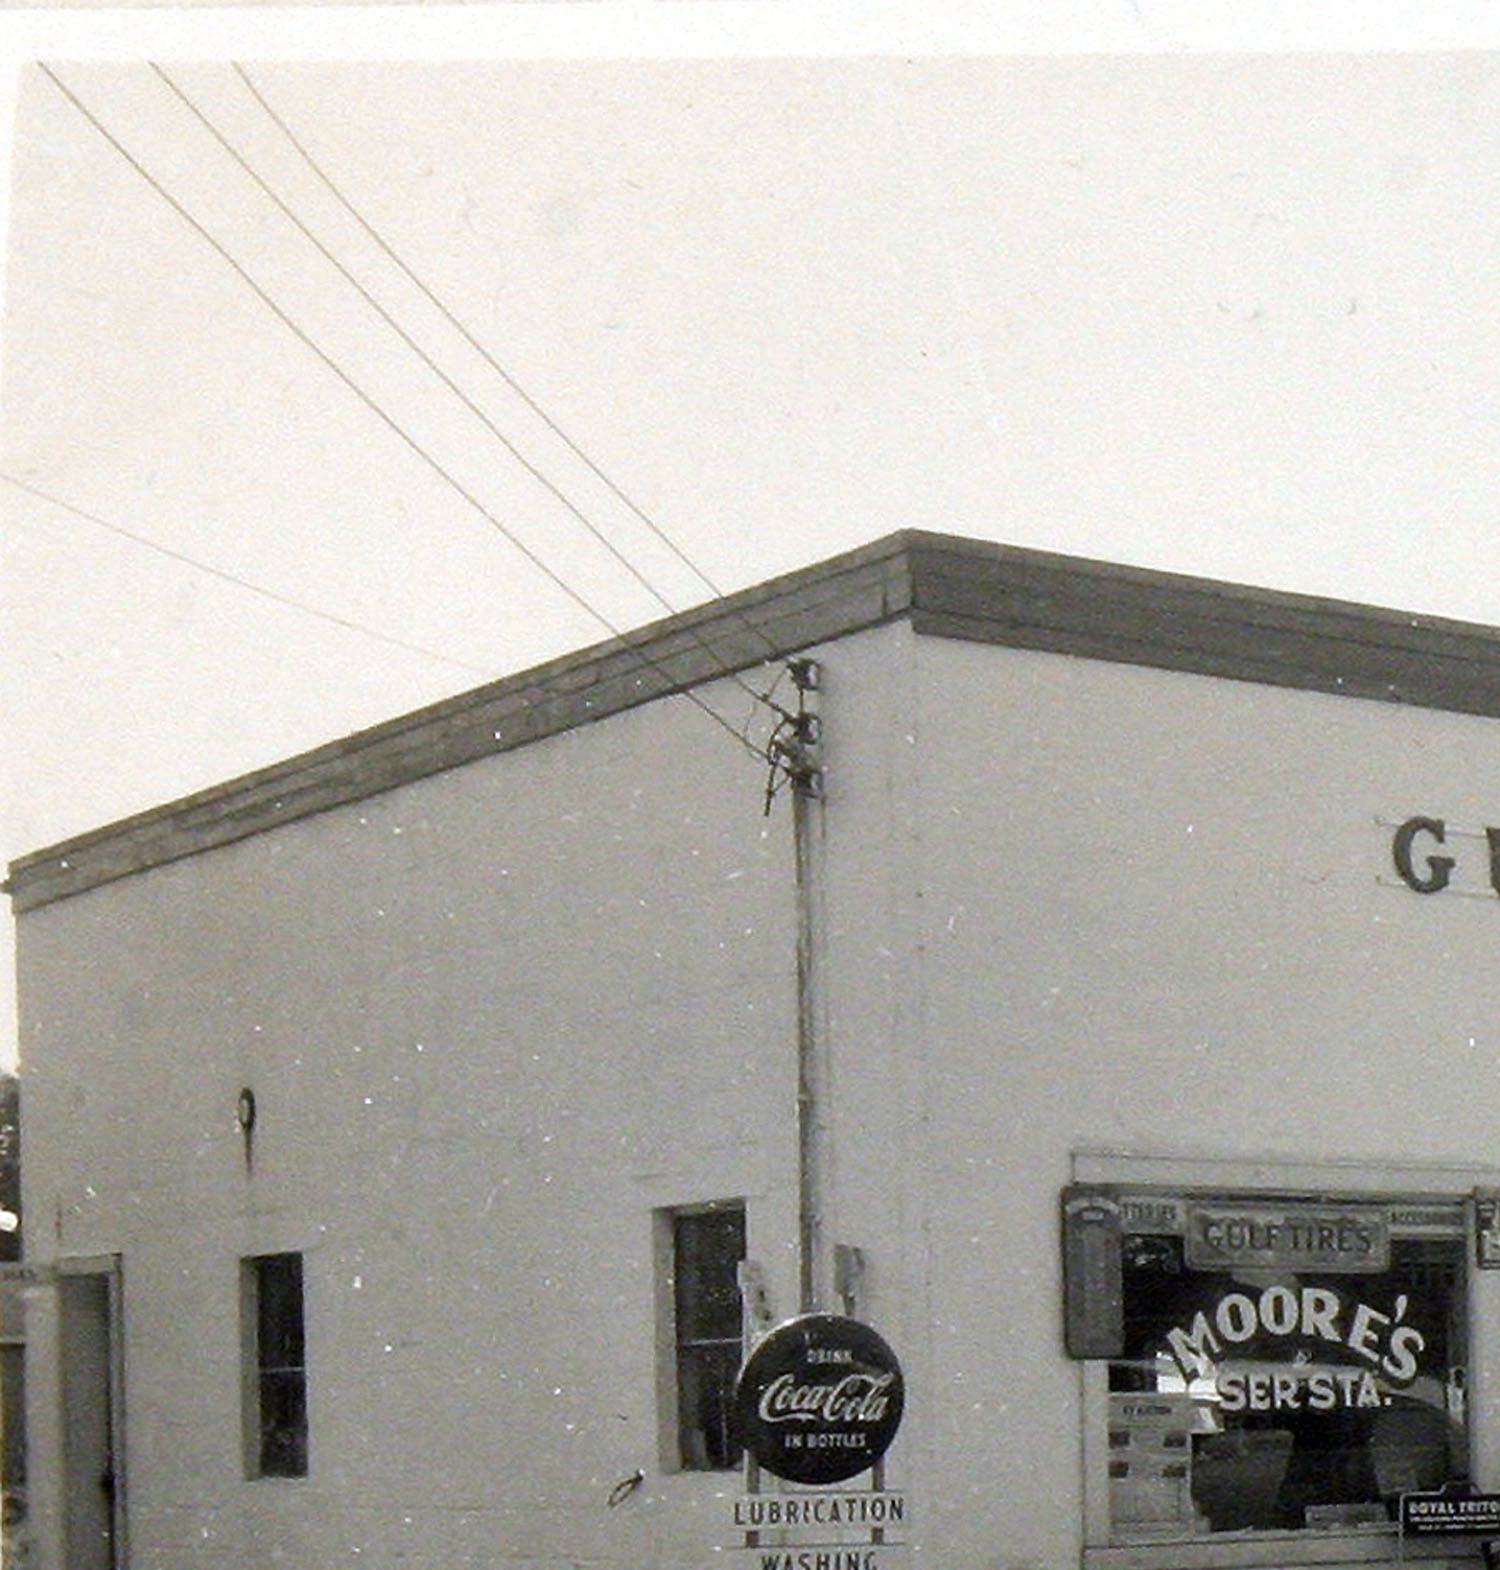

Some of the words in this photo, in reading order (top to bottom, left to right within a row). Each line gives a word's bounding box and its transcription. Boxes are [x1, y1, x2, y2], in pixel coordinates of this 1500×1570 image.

[1204, 1217, 1279, 1251] GULF
[1287, 1220, 1373, 1254] TIRES
[1166, 1286, 1425, 1381] MOORE'S
[806, 1349, 853, 1364] DRINK
[785, 1434, 802, 1448] IN
[806, 1432, 867, 1448] BOTTLES
[733, 1496, 904, 1528] LUBRICATION
[1408, 1501, 1456, 1514] ROYAL
